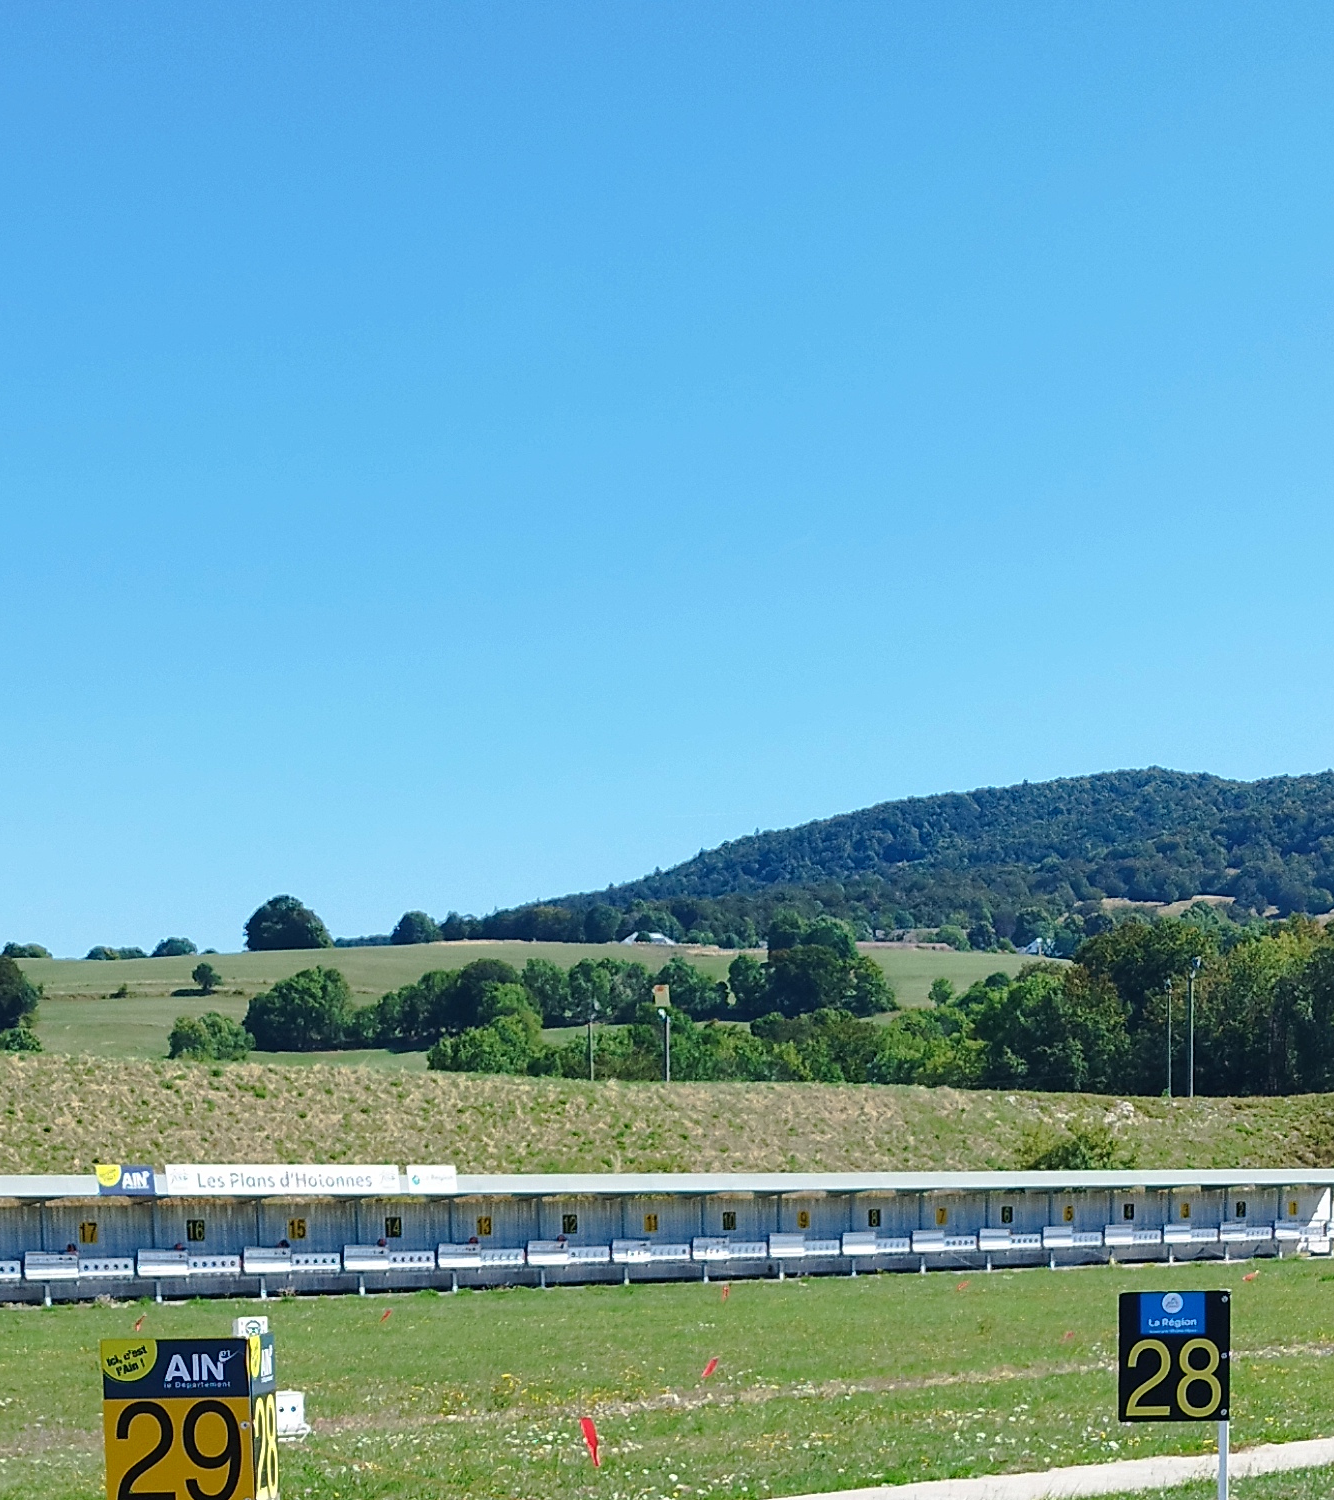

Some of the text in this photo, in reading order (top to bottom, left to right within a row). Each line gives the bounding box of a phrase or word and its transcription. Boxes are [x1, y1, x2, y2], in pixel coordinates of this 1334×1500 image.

[197, 1172, 225, 1188] Les
[230, 1172, 275, 1188] Plans
[478, 1216, 491, 1235] 13
[563, 1215, 577, 1233] 12
[645, 1214, 657, 1231] 11
[723, 1212, 736, 1229] 10
[799, 1211, 808, 1227] 9
[870, 1210, 879, 1225] 8
[938, 1209, 947, 1224] 7
[80, 1222, 98, 1243] 17
[188, 1220, 204, 1239] 16
[289, 1219, 306, 1238] 15
[386, 1217, 401, 1236] 14
[1149, 1318, 1197, 1328] La Région
[165, 1353, 224, 1381] AIN
[1126, 1338, 1222, 1418] 28
[254, 1394, 279, 1500] 28
